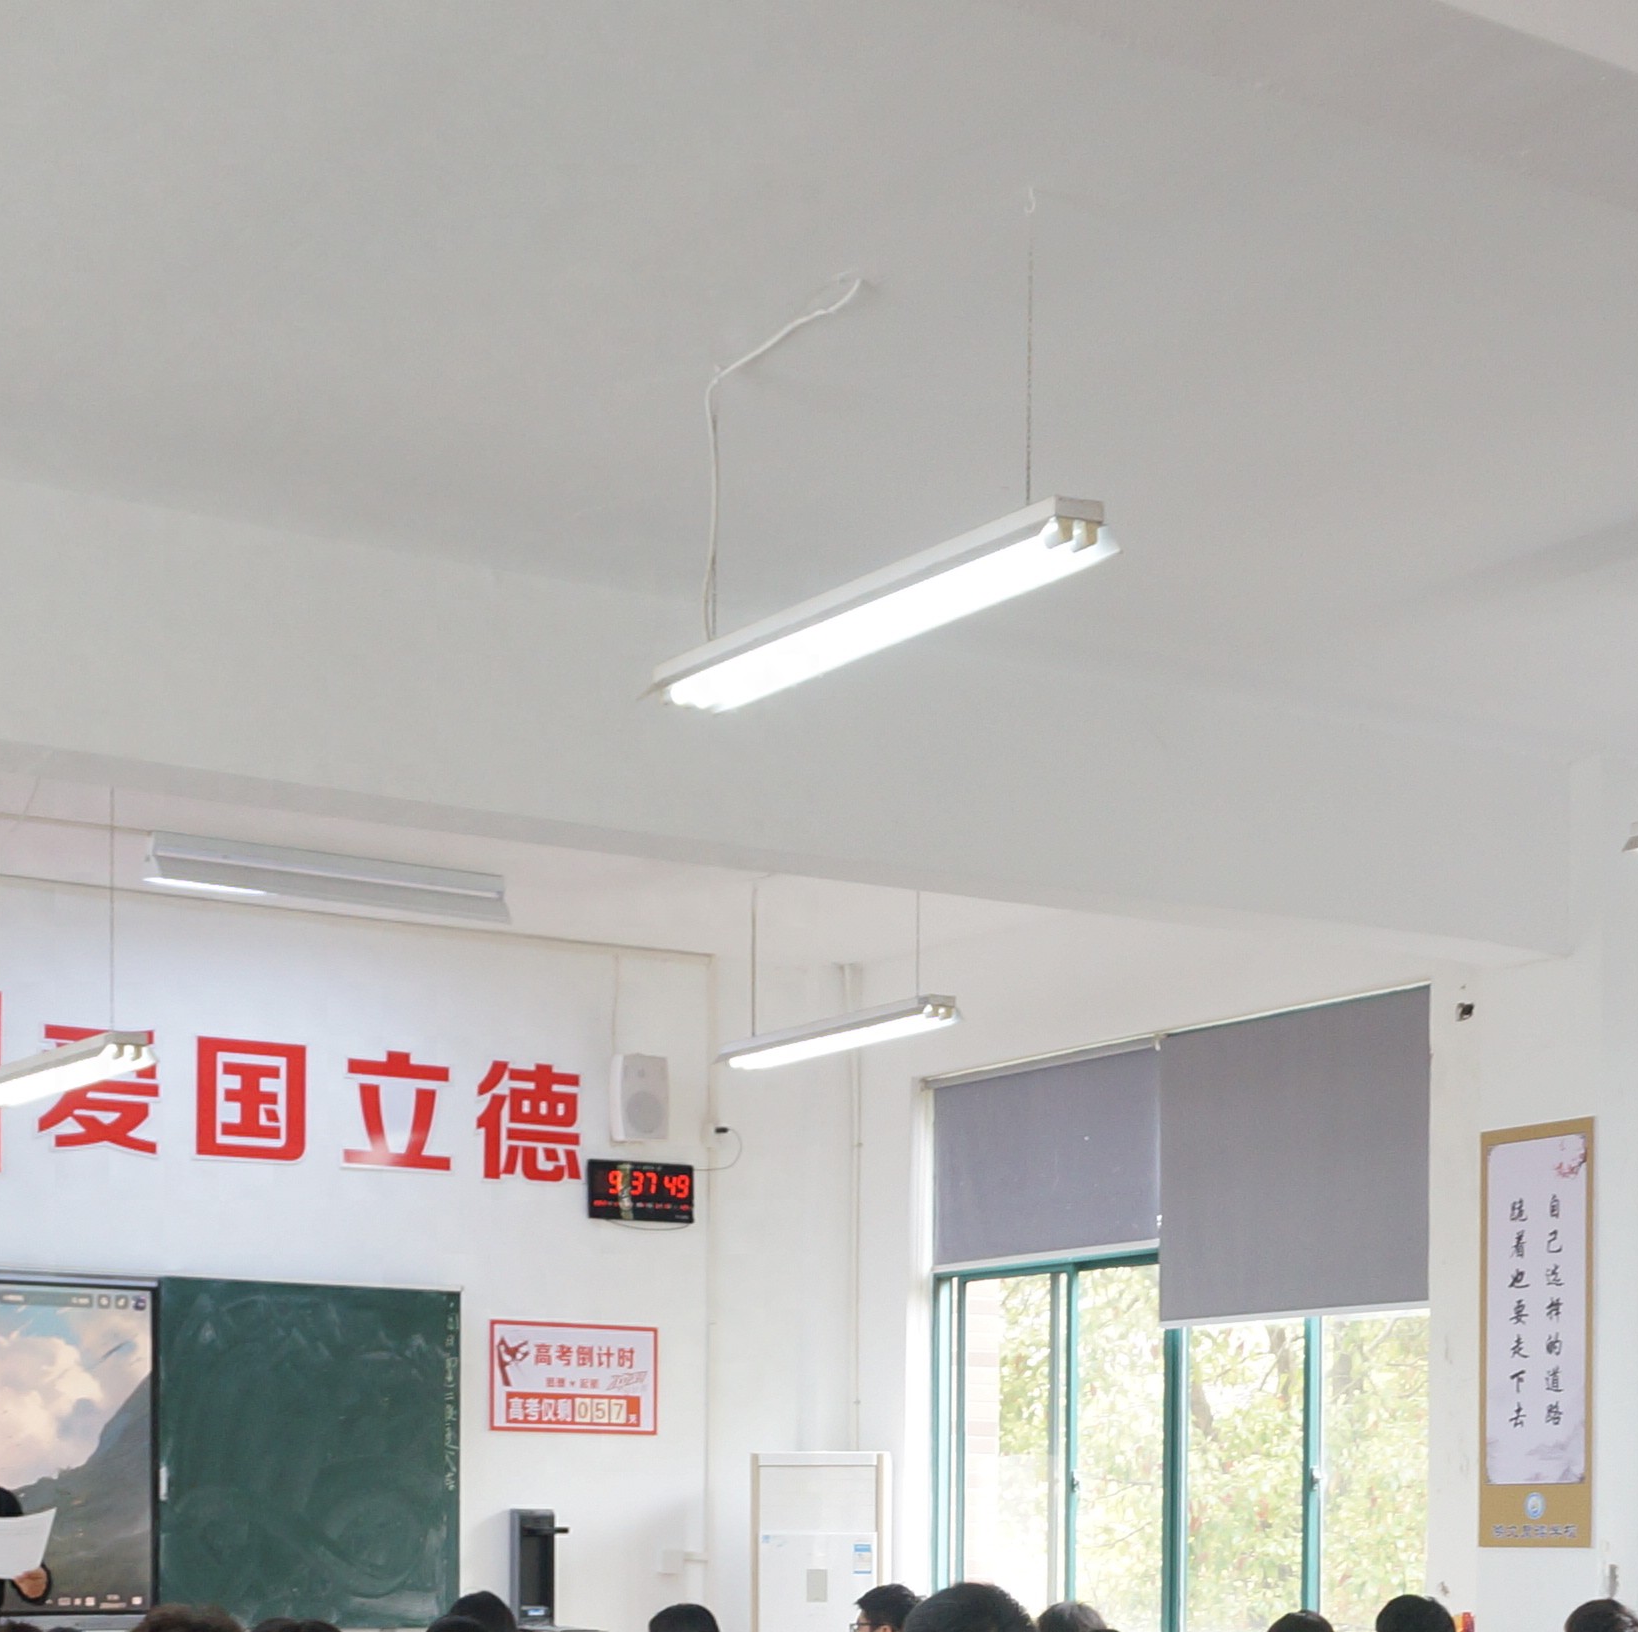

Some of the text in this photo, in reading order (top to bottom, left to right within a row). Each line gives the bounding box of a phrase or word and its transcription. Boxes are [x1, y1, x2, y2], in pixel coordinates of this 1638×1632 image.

[36, 1022, 583, 1183] 爱国立德
[533, 1343, 636, 1369] 高考倒计时
[1544, 1193, 1566, 1427] 自己选择的道路
